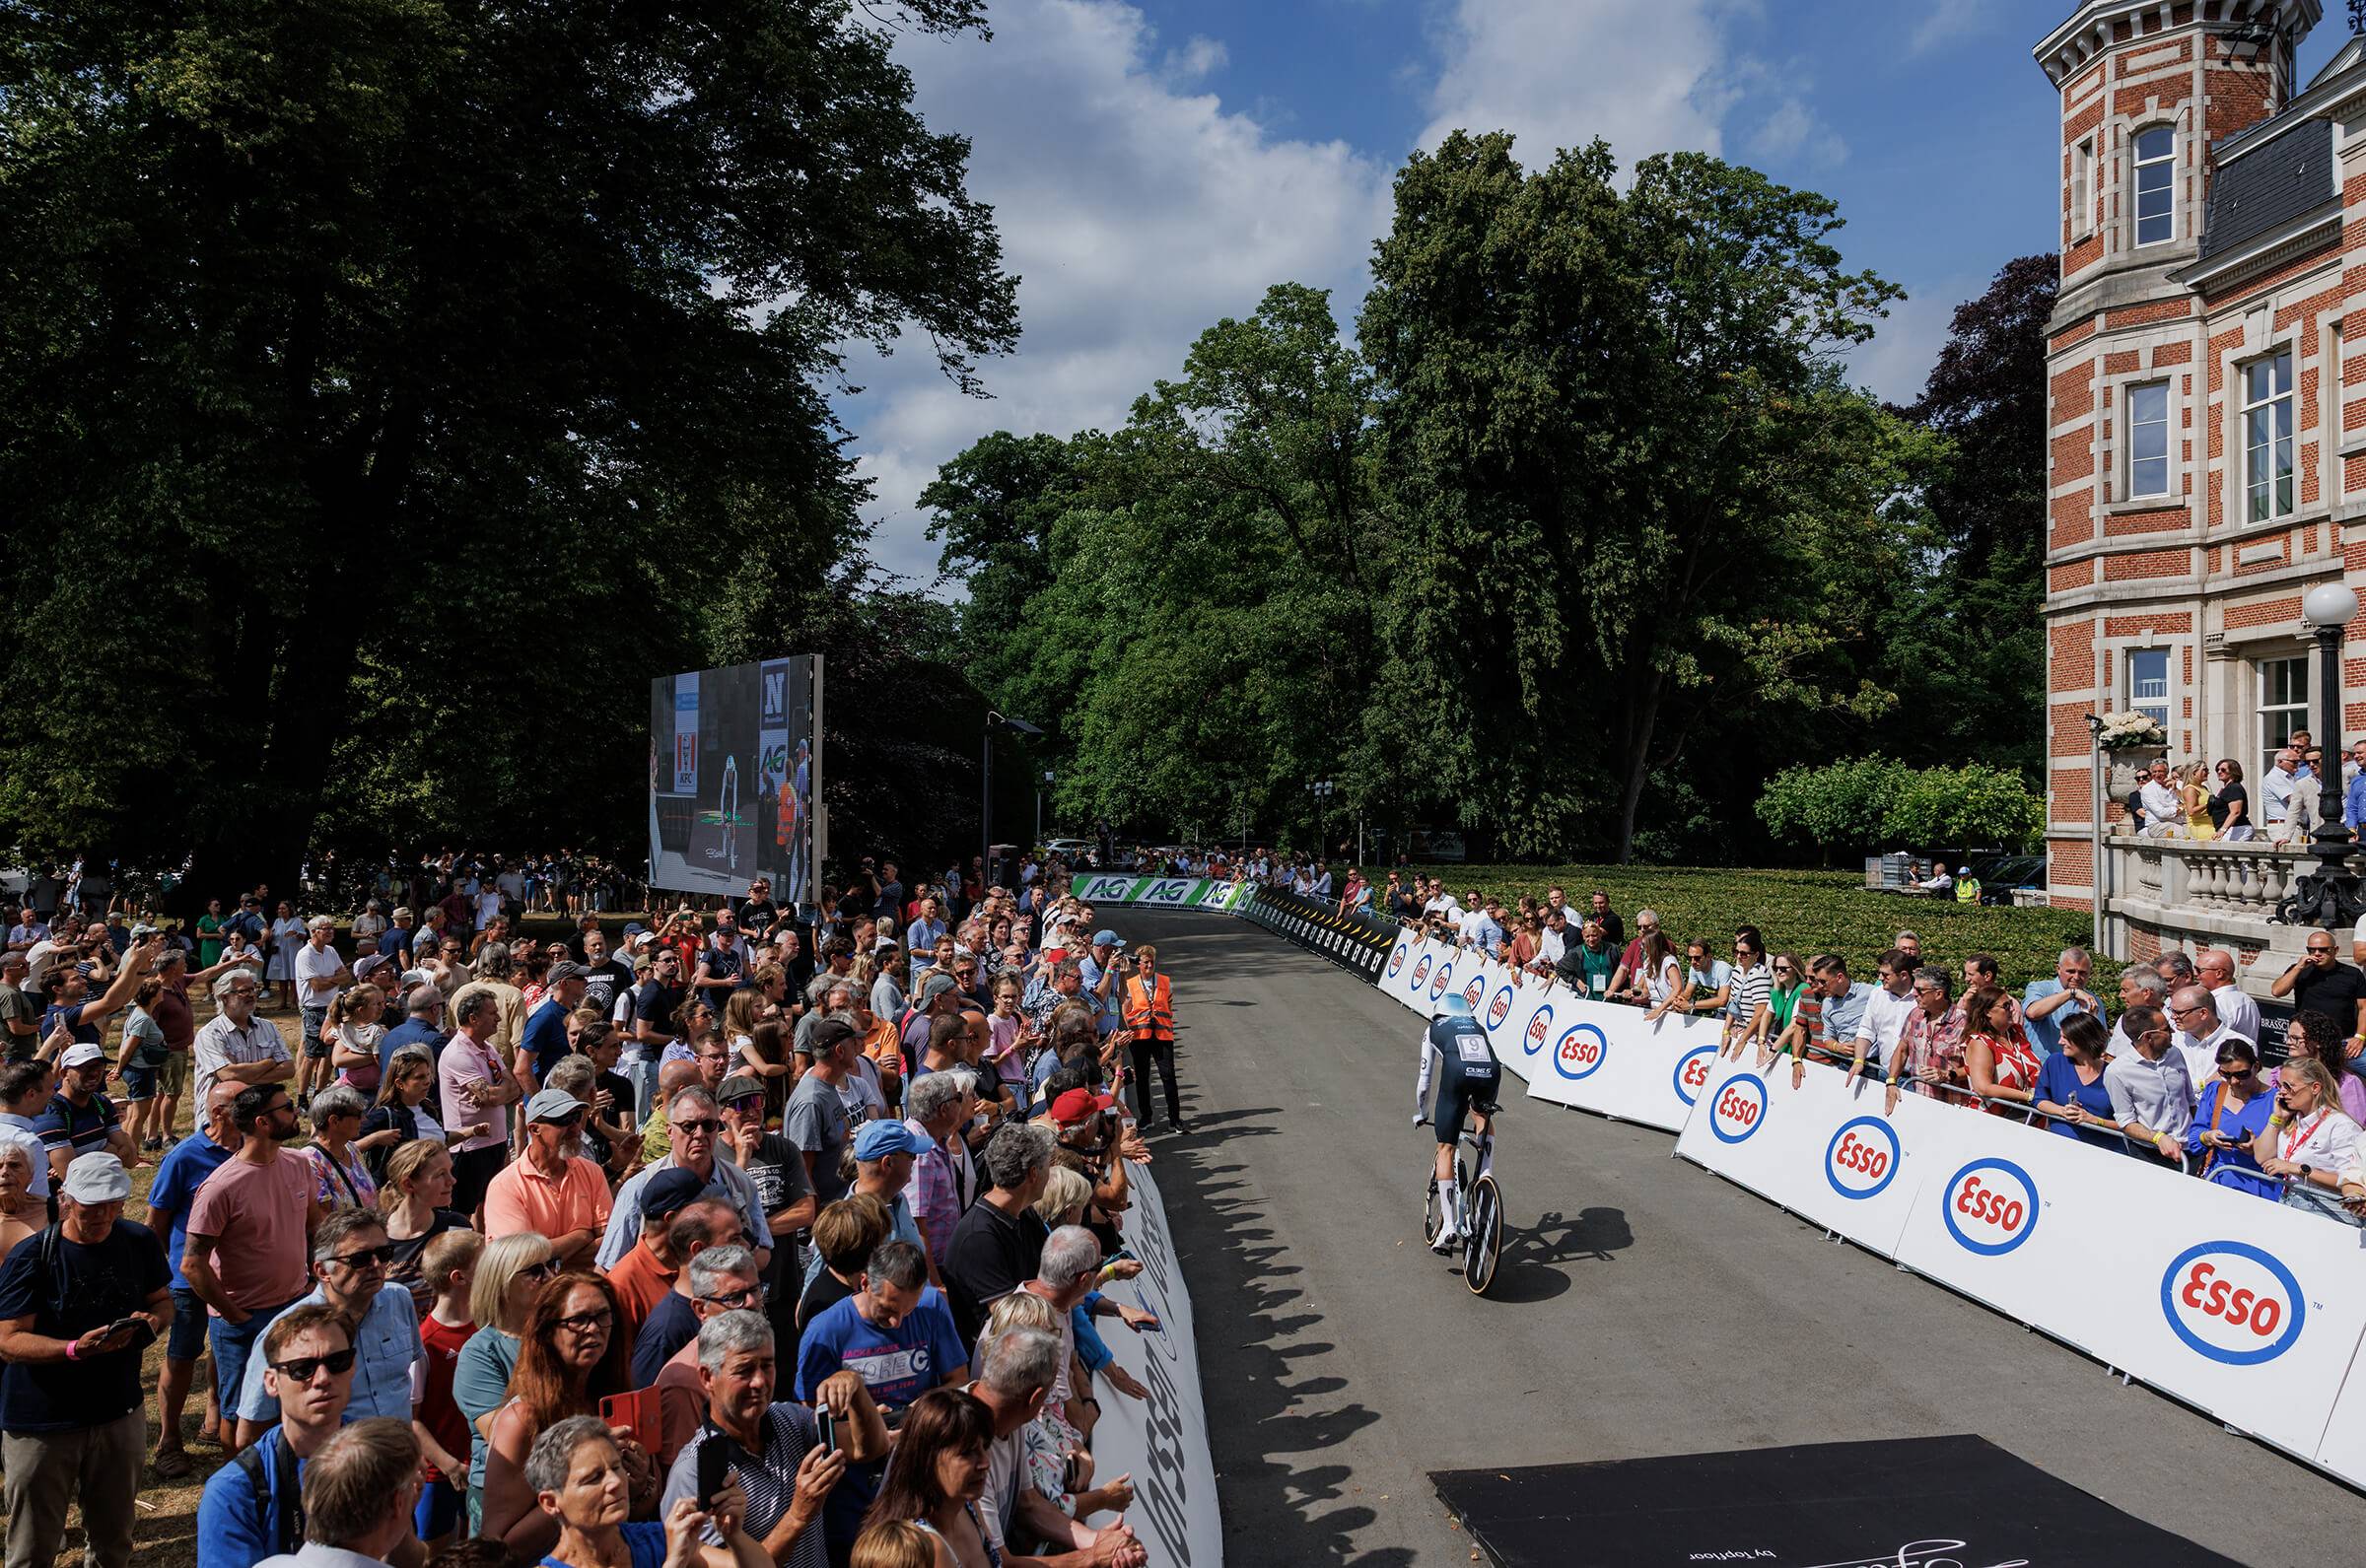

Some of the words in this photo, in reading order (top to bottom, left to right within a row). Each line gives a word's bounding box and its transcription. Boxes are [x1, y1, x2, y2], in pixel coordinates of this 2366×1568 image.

[679, 772, 692, 784] KFC
[1086, 878, 1127, 899] AG
[1145, 880, 1188, 902] AG
[1201, 882, 1232, 904] AG
[2261, 1017, 2290, 1031] BRASSC
[1469, 1038, 1480, 1052] 9
[1684, 1058, 1708, 1087] Es
[2312, 1301, 2324, 1311] TM
[1689, 1547, 1756, 1561] Topfloor
[1755, 1548, 1776, 1560] by
